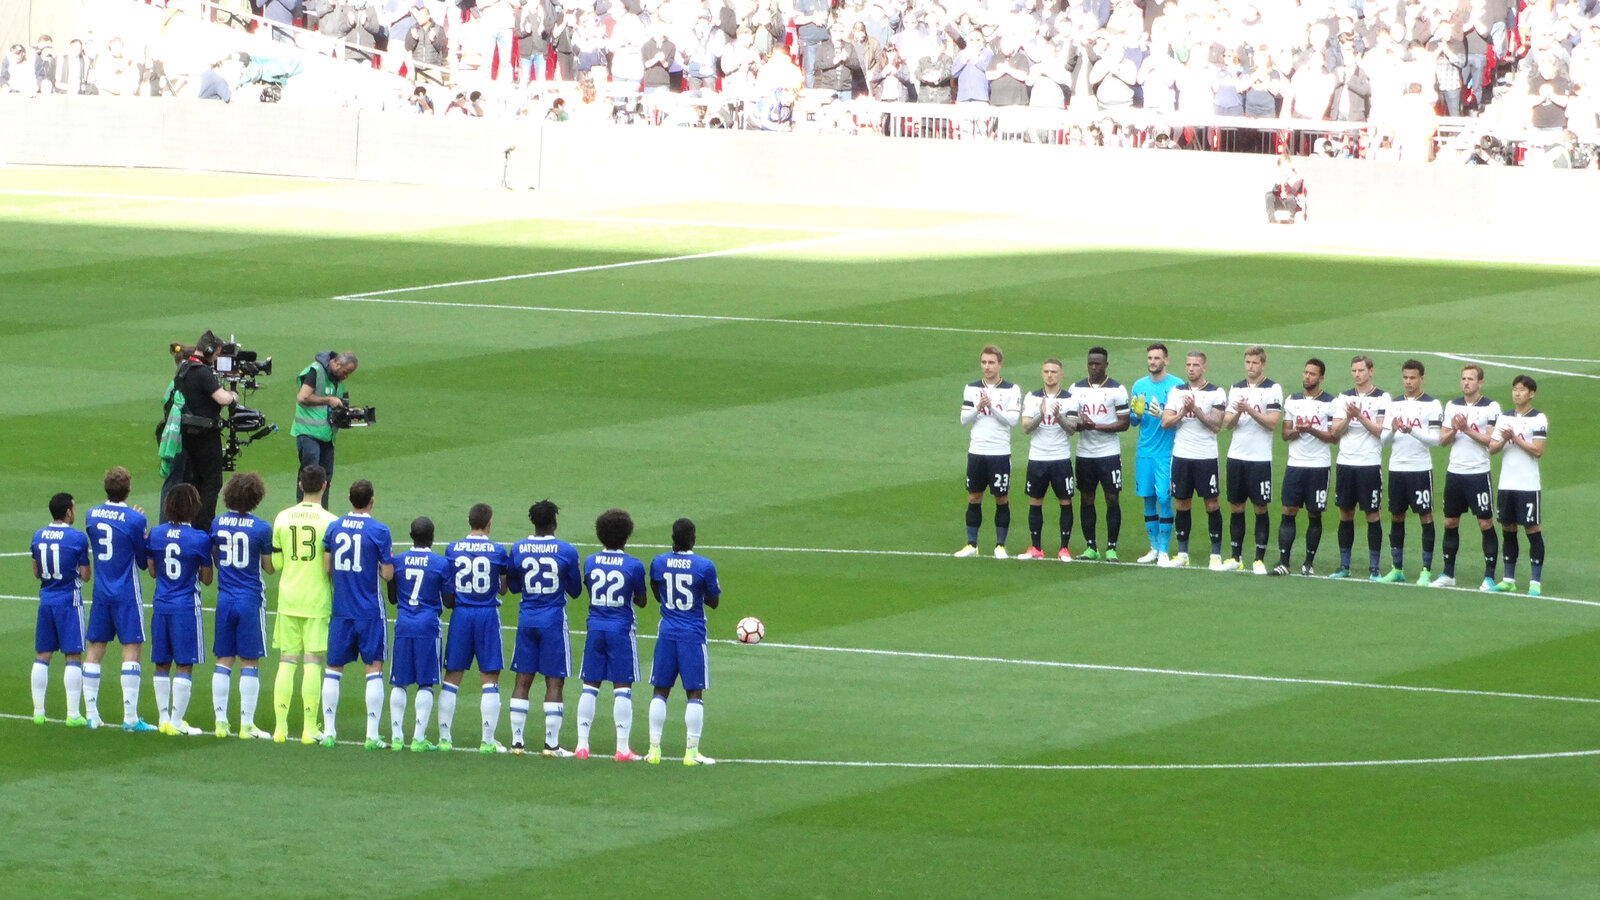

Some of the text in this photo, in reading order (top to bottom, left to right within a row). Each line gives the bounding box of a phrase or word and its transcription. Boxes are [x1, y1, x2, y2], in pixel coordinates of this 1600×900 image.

[1082, 403, 1107, 415] AIA
[993, 473, 1009, 488] 23
[1111, 469, 1121, 484] 12
[1209, 474, 1216, 487] 4
[1259, 481, 1270, 495] 15
[1315, 490, 1326, 503] 19
[1371, 490, 1378, 503] 5
[1415, 490, 1430, 505] 20
[1477, 492, 1489, 507] 10
[91, 508, 126, 522] MARCOS A.
[1526, 503, 1534, 518] 7
[218, 517, 255, 528] DAVID LUIZ
[341, 519, 364, 530] MATIC
[41, 530, 64, 540] PEDRO
[166, 528, 181, 539] AKE
[96, 522, 113, 561] 3
[289, 525, 316, 561] 13
[453, 542, 495, 553] AZPILICUETA
[519, 543, 558, 554] BATSHUAYI
[217, 530, 250, 569] 30
[334, 532, 362, 573] 21
[38, 542, 63, 580] 11
[164, 542, 181, 580] 6
[405, 555, 429, 567] KANTÉ
[595, 555, 624, 566] WILLIAN
[666, 558, 691, 569] MOSES
[454, 555, 491, 594] 28
[521, 556, 559, 594] 23
[405, 568, 424, 606] 7
[590, 568, 625, 607] 22
[663, 572, 694, 611] 15
